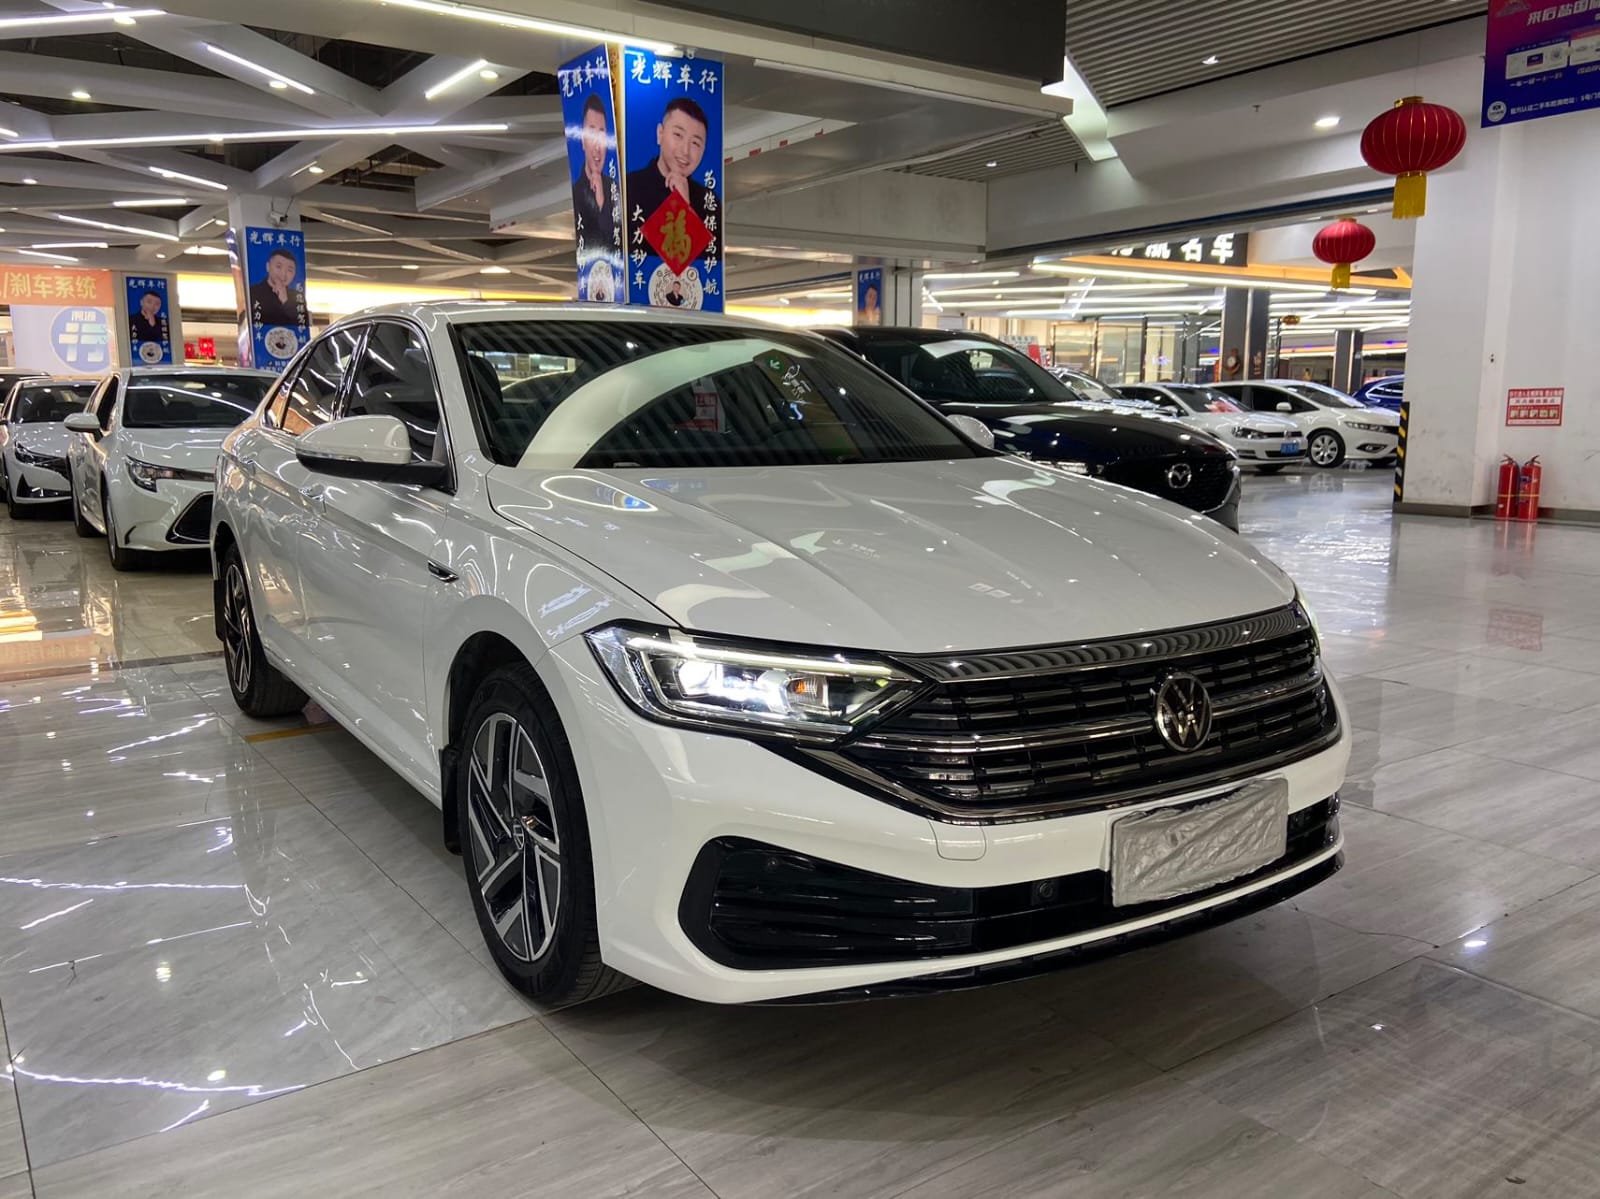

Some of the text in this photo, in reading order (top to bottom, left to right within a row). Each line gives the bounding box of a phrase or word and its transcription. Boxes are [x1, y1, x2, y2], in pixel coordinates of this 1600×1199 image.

[630, 53, 718, 94] 光辉车行
[659, 208, 692, 263] 福
